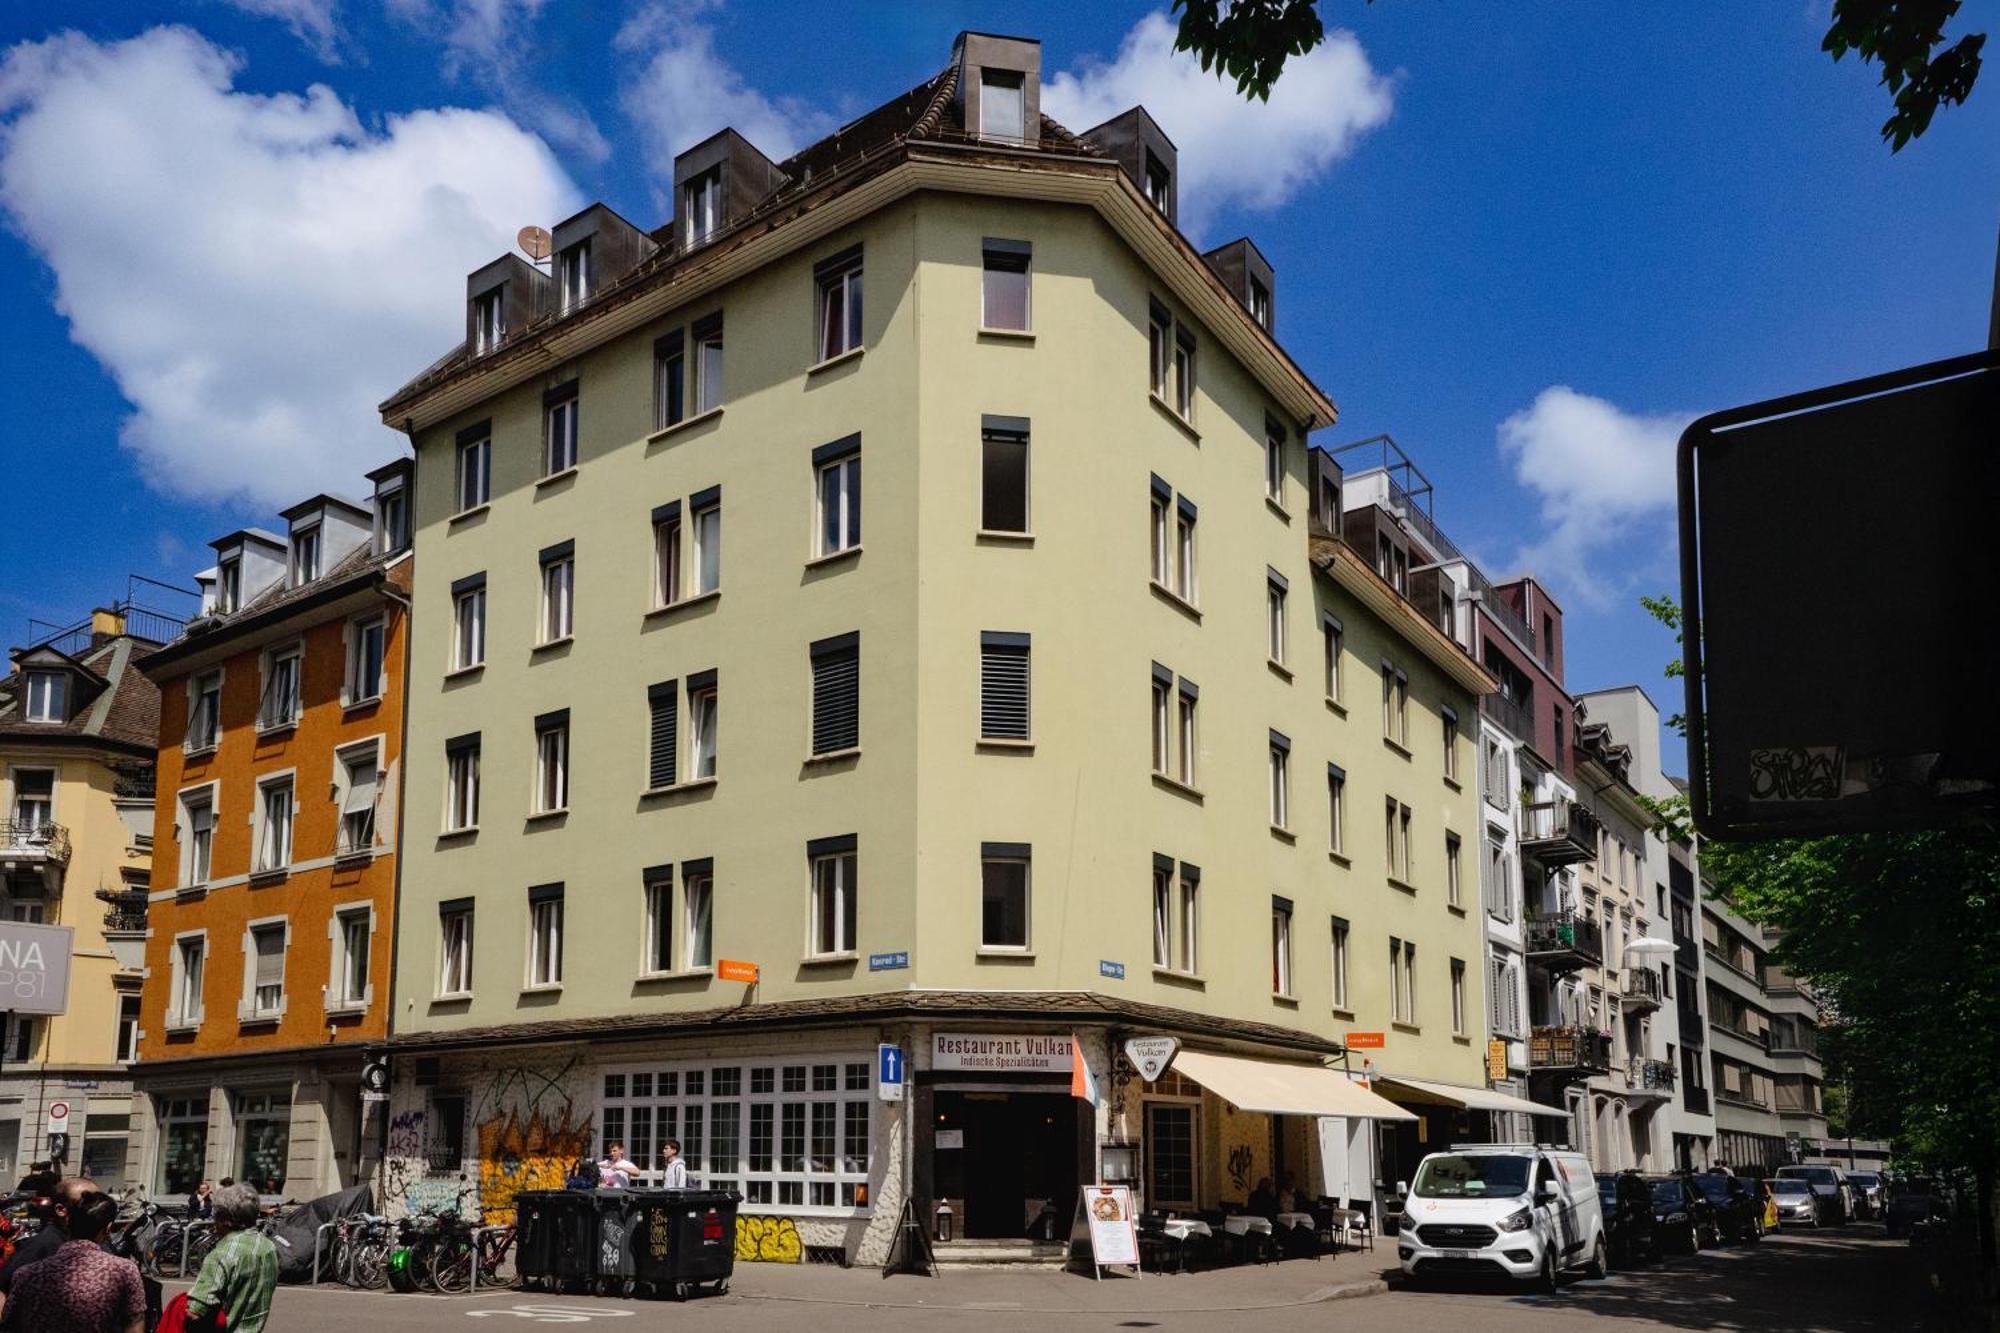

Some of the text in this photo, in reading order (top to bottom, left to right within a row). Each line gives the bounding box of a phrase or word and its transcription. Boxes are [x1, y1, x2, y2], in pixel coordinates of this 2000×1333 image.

[938, 1037, 1073, 1055] Restaurant Vulkan
[1136, 1048, 1166, 1057] Vulkan
[961, 1056, 1049, 1068] Indische Spezialitäten
